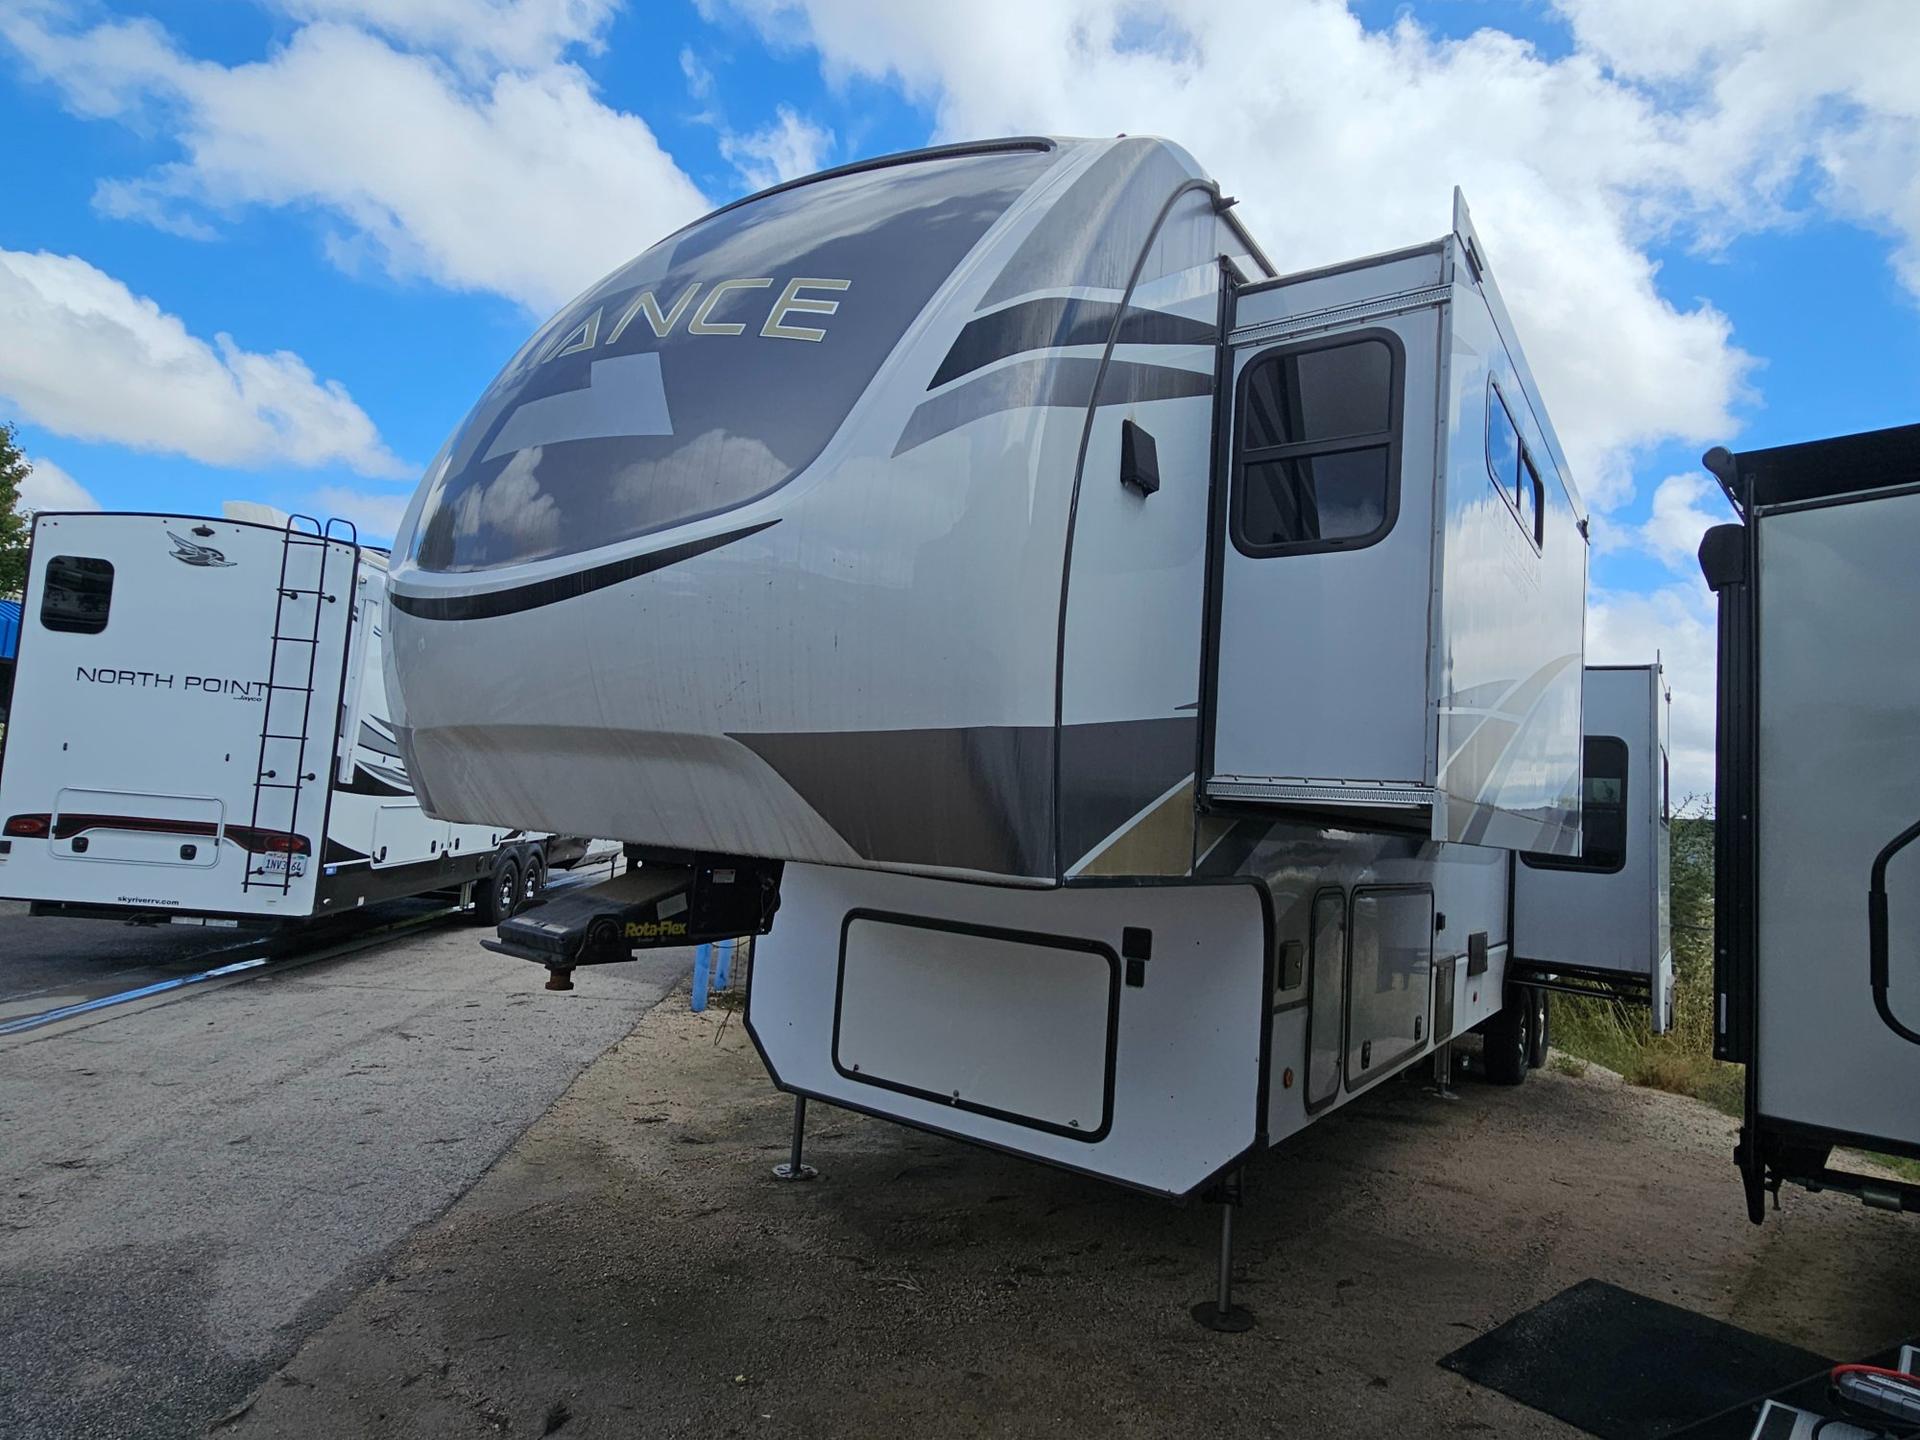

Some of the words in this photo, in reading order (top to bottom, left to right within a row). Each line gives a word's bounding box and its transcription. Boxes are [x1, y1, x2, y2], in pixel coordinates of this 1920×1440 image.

[76, 666, 174, 688] NORTH
[184, 675, 268, 697] POINT
[265, 859, 302, 872] 1NV364
[117, 896, 179, 905] skyriverrv.com
[626, 922, 687, 936] Rota-Flex
